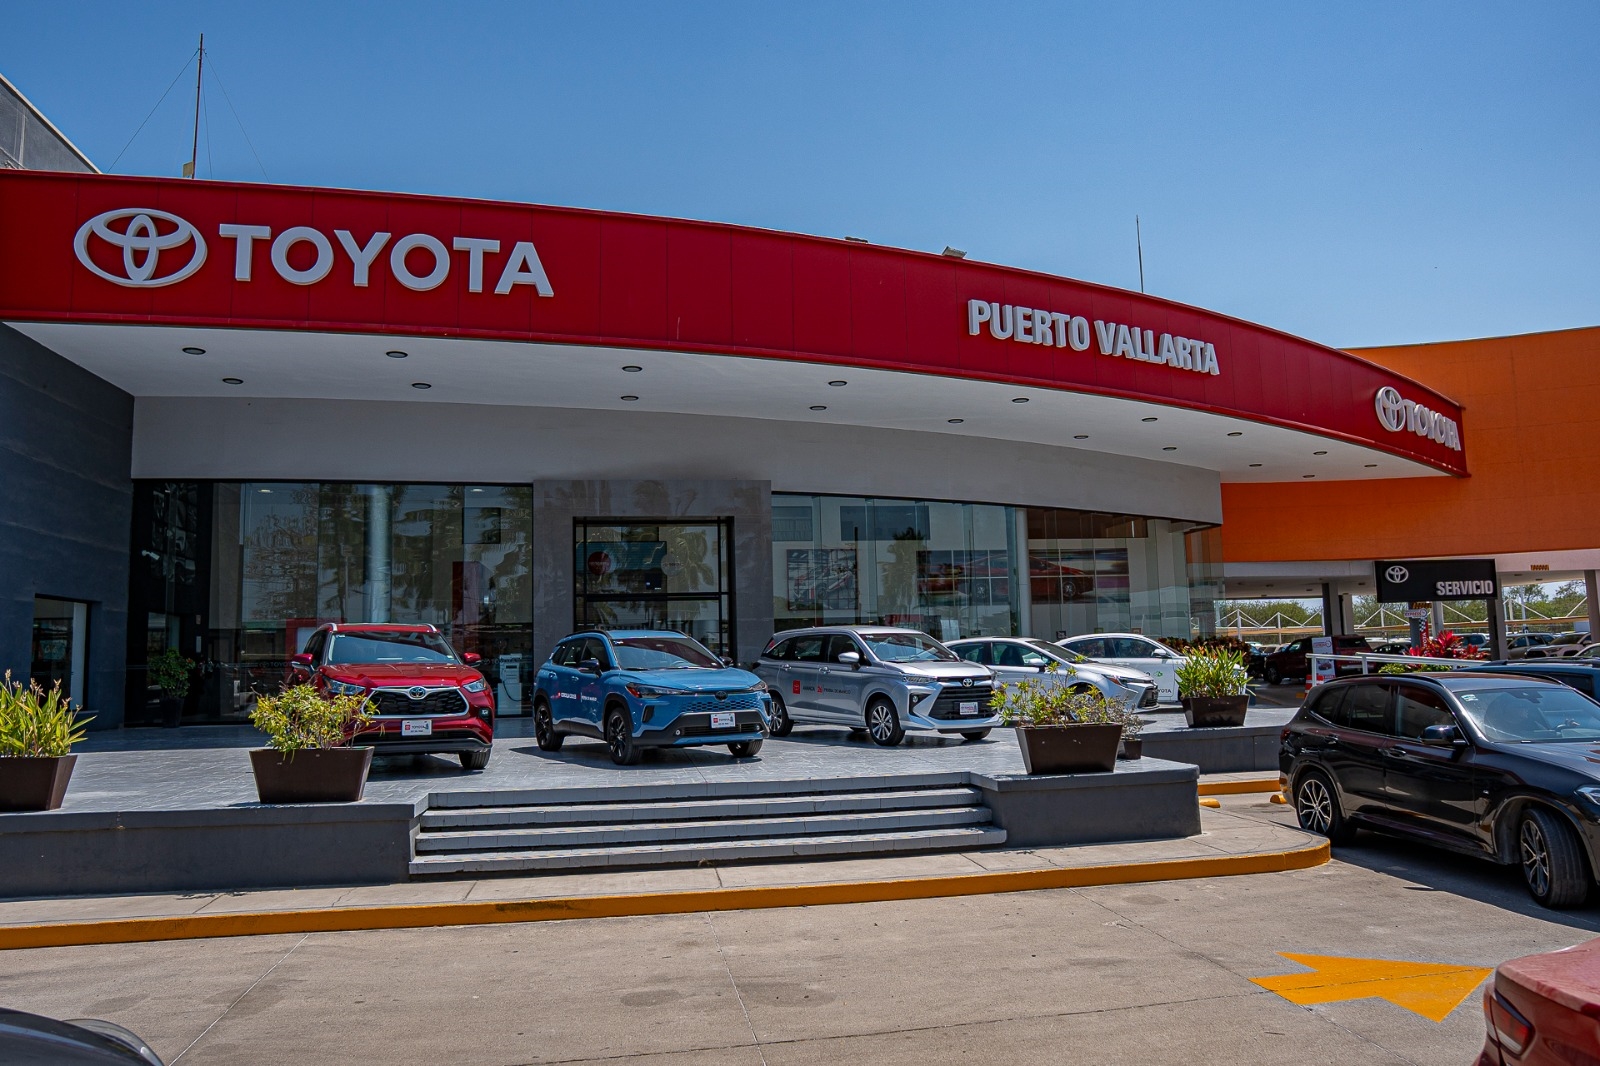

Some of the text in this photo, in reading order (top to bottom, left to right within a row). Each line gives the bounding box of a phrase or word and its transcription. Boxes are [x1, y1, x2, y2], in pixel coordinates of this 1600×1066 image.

[219, 223, 554, 297] TOYOTA
[968, 299, 1220, 376] PUERTO VALLARTA
[1402, 398, 1461, 451] TOYOTA
[1436, 580, 1494, 596] SERVICIO
